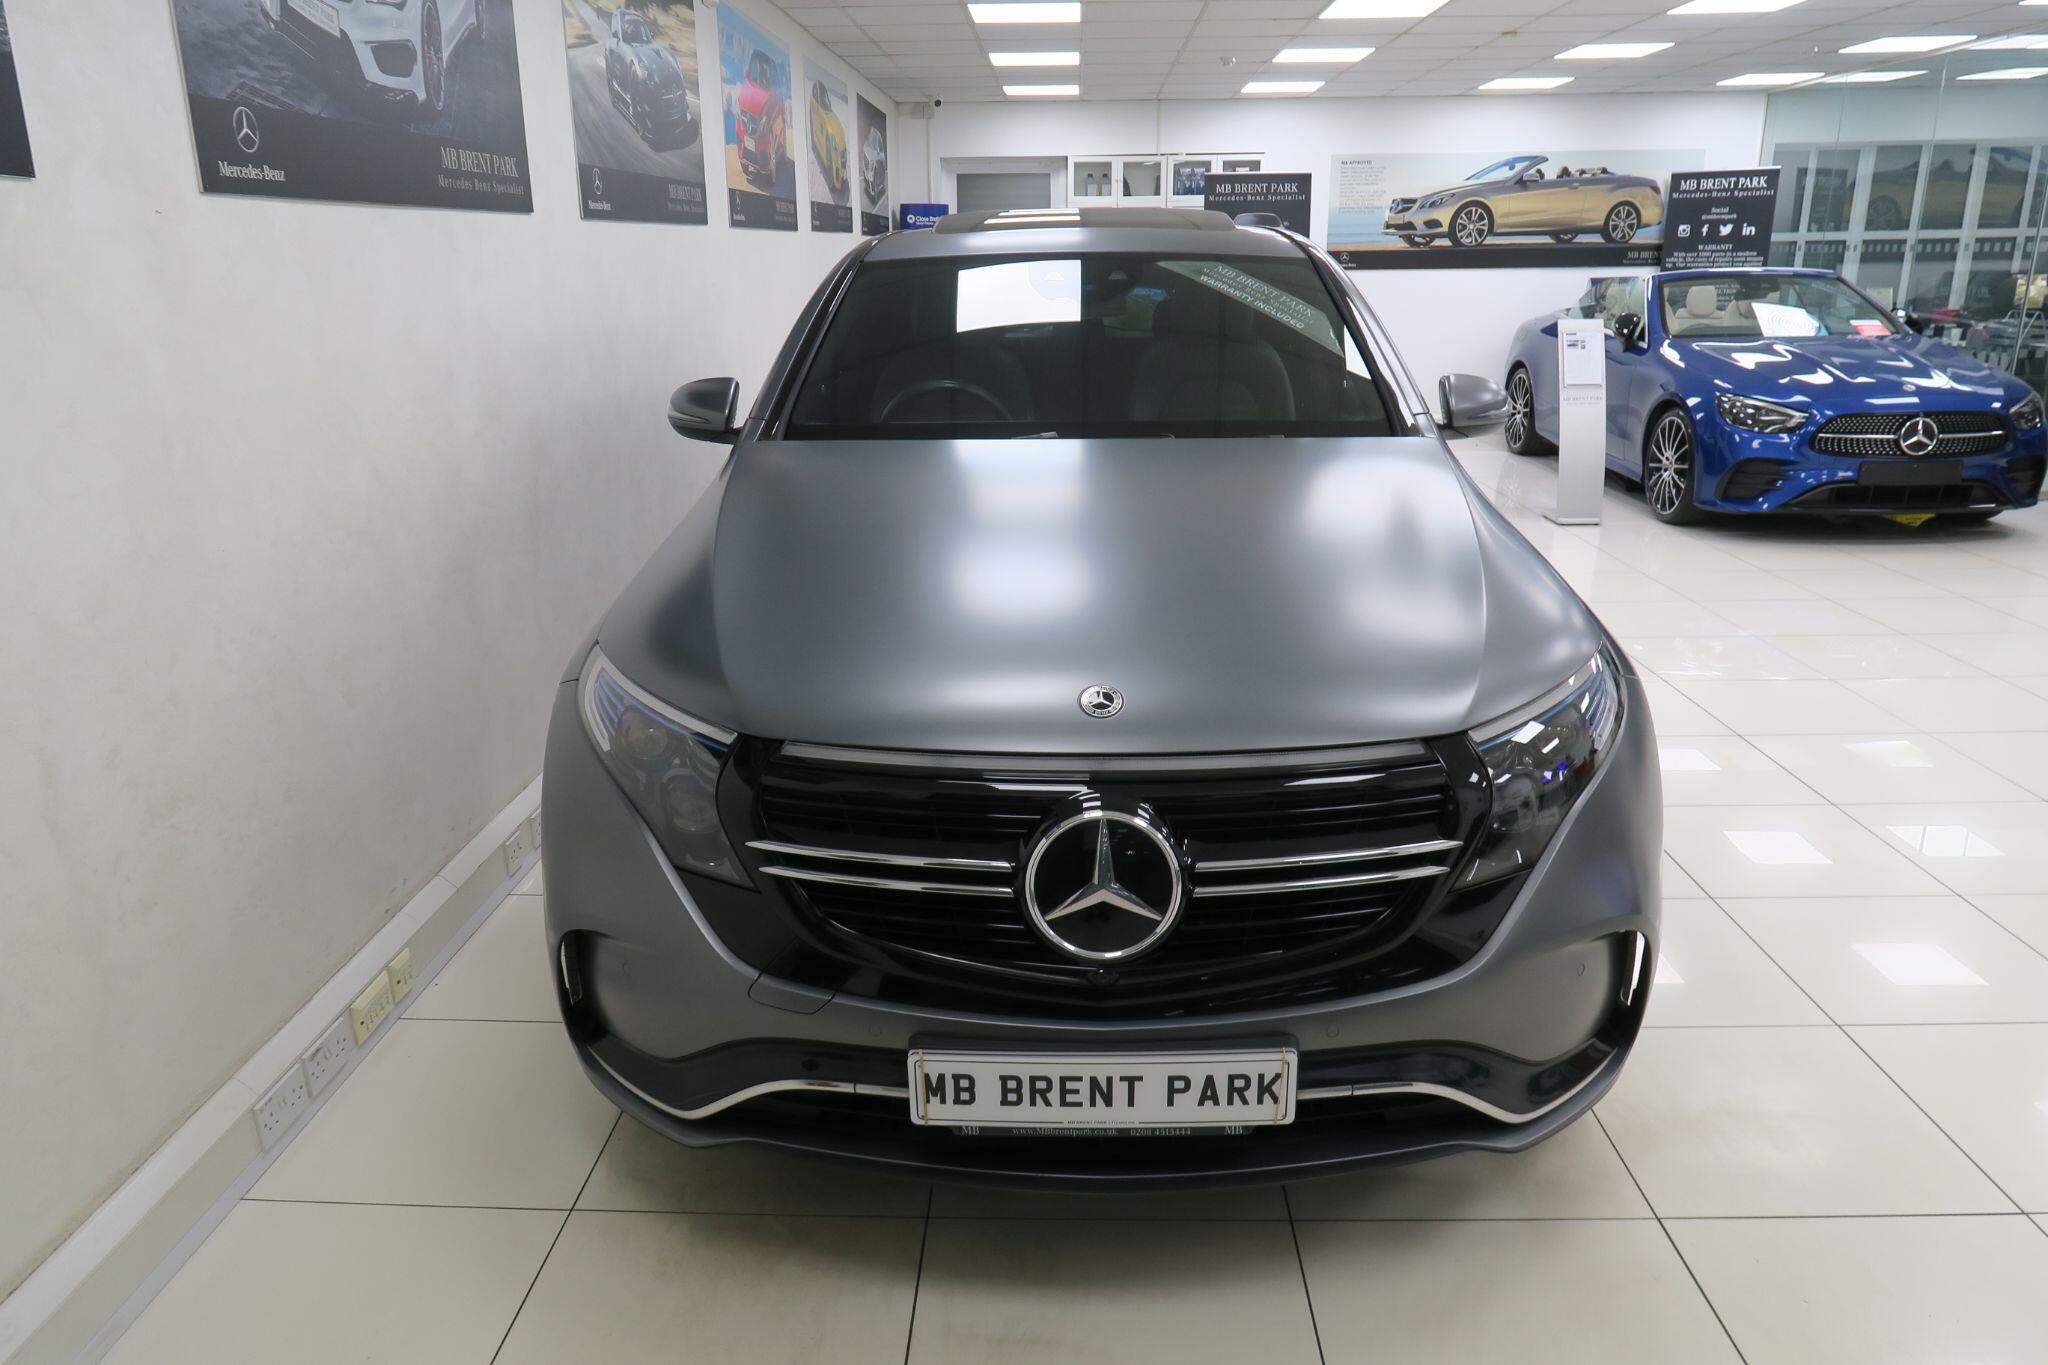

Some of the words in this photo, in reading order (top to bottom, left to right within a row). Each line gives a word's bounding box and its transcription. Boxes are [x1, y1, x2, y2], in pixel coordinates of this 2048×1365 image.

[218, 160, 286, 181] Mercedes-Benz
[440, 146, 458, 170] MB
[458, 149, 491, 174] BRENT
[492, 154, 519, 178] PARK
[1216, 184, 1232, 194] MB
[1235, 183, 1268, 193] BRENT
[1271, 183, 1298, 193] PARK
[1680, 179, 1697, 191] MB
[1700, 178, 1737, 190] BRENT
[1738, 176, 1768, 188] PARK
[1268, 194, 1306, 202] Specialist
[1734, 189, 1774, 198] Specialist
[1215, 265, 1236, 278] MB
[1236, 275, 1279, 297] BRENT
[1280, 295, 1314, 317] PARK
[1200, 275, 1254, 302] WARRANTY
[1254, 300, 1305, 329] INCLUDED
[924, 1073, 976, 1105] MB
[999, 1074, 1143, 1107] BRENT
[1166, 1073, 1282, 1107] PARK
[961, 1126, 980, 1135] MB
[1224, 1125, 1242, 1135] MB
